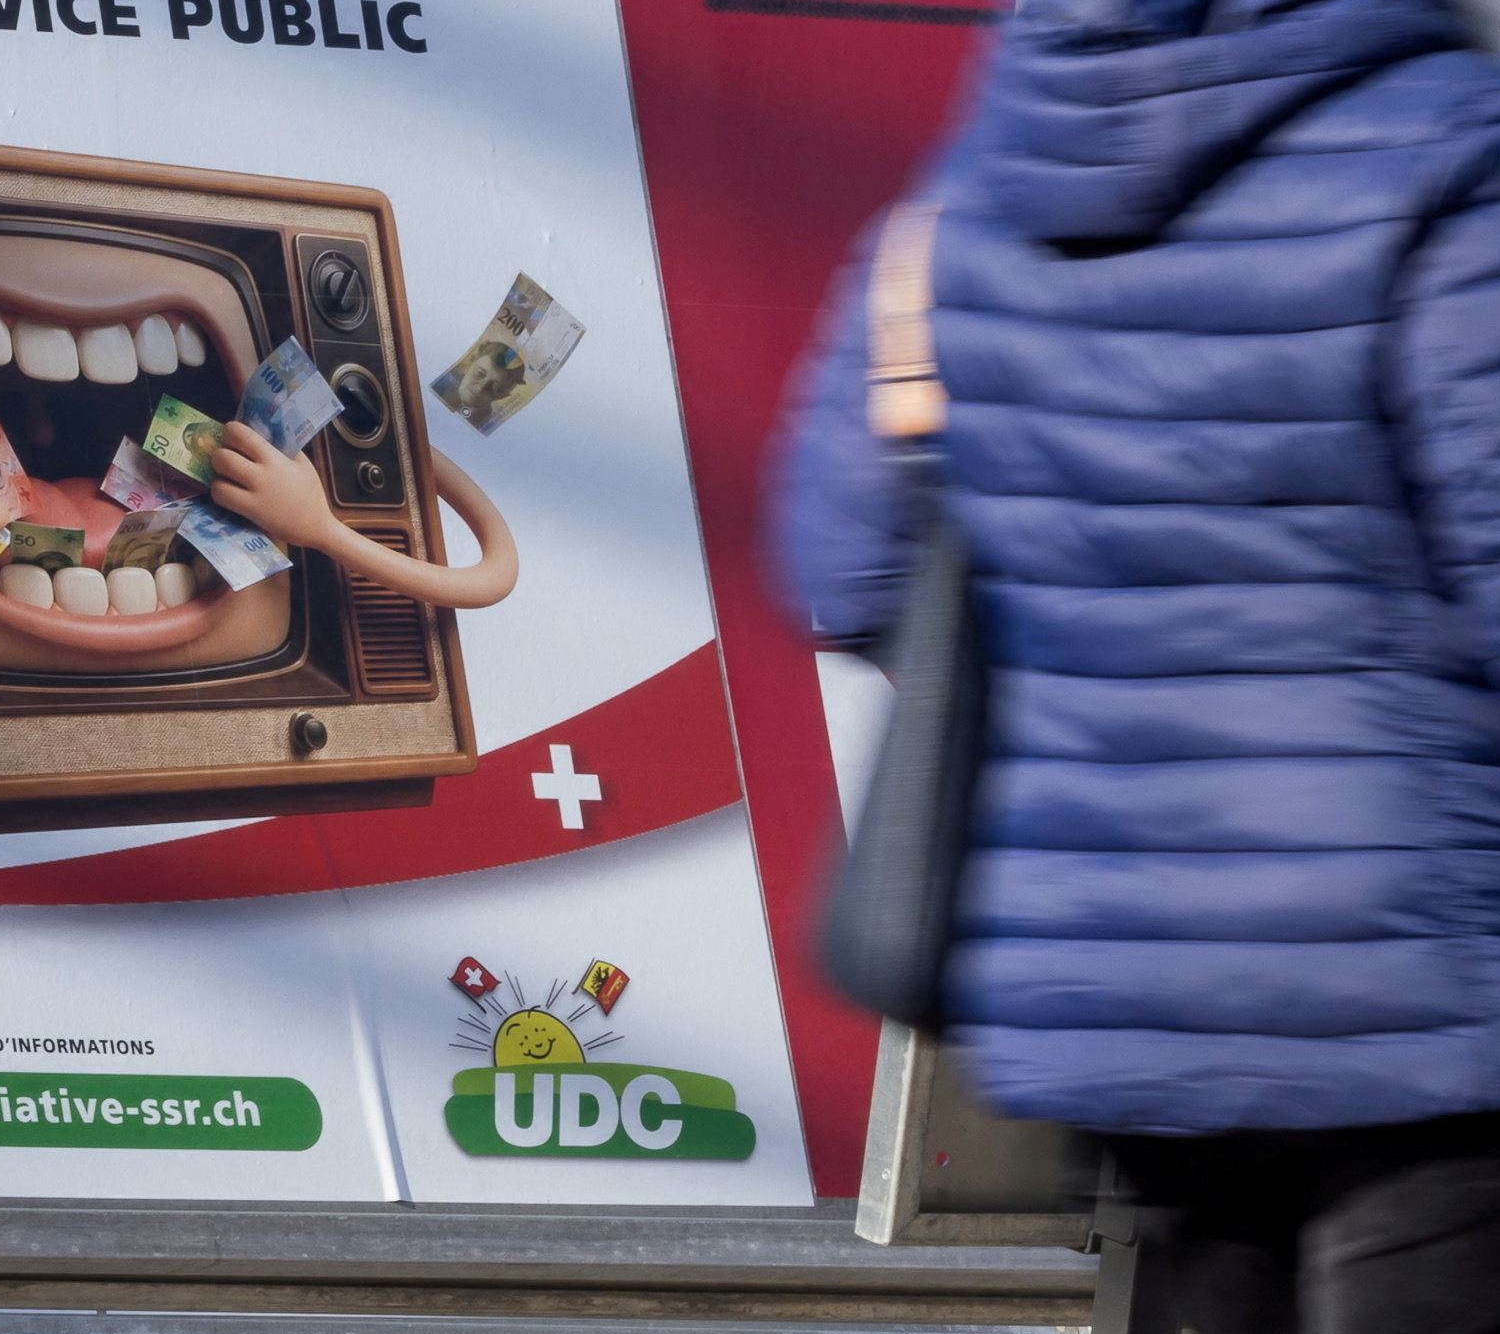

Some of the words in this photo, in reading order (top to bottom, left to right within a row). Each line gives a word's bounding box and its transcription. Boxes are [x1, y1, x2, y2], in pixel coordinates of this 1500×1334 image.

[497, 307, 525, 337] 200
[261, 366, 284, 394] 100
[152, 434, 170, 456] 50
[13, 533, 37, 548] 50
[494, 1073, 683, 1151] UDC
